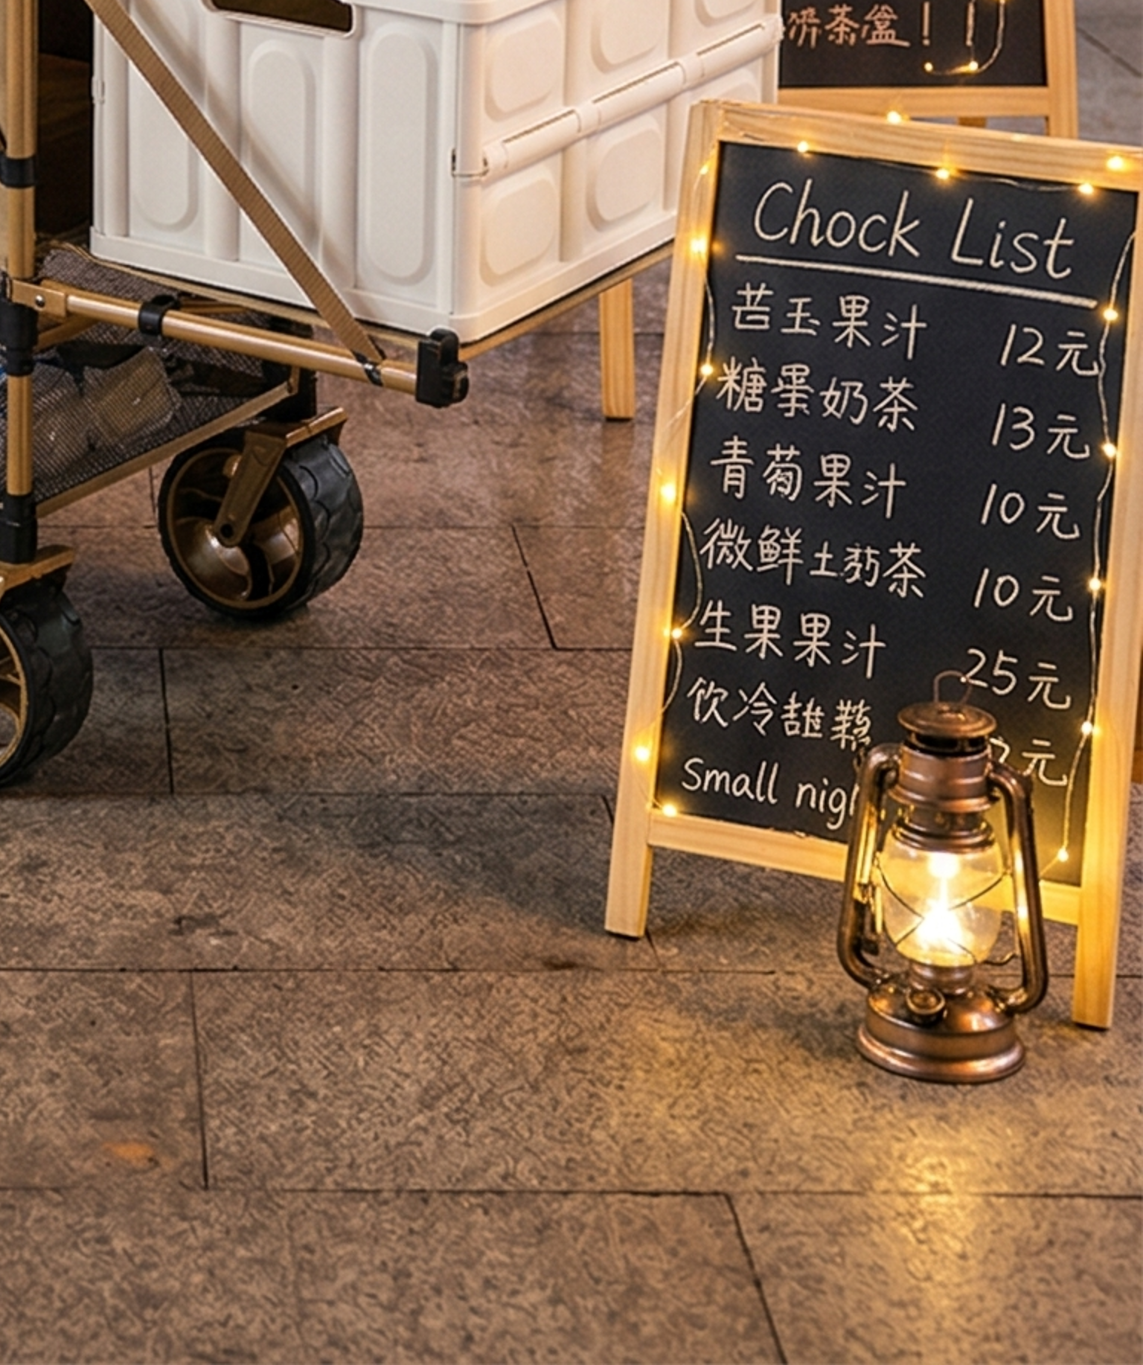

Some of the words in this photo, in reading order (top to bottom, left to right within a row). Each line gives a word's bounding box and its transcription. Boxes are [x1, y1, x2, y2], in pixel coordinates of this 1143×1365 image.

[754, 178, 920, 257] Chock
[951, 198, 1074, 279] List
[1000, 324, 1099, 376] 12元
[993, 404, 1089, 458] 13元
[982, 485, 1079, 538] 10元
[975, 569, 1072, 620] 10元
[694, 600, 886, 679] 生果果汁
[963, 648, 1071, 710] 25元
[681, 757, 779, 804] Small
